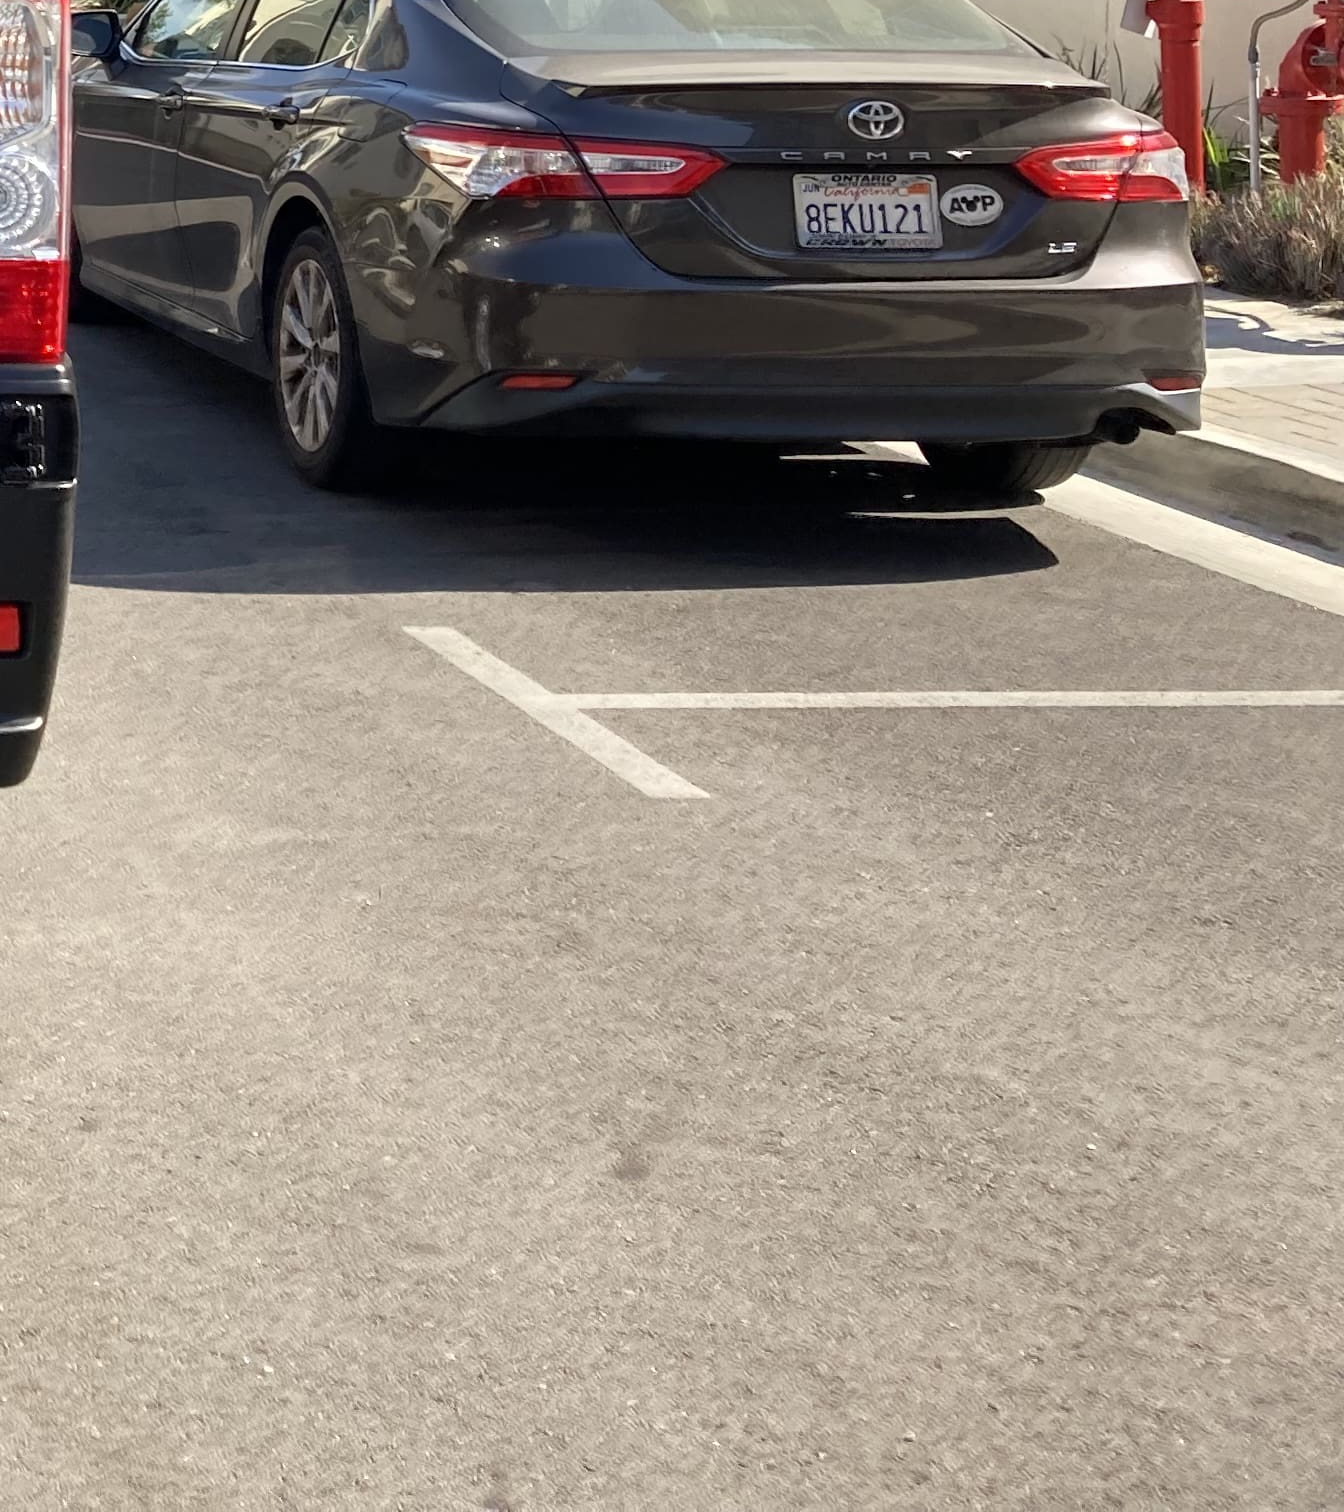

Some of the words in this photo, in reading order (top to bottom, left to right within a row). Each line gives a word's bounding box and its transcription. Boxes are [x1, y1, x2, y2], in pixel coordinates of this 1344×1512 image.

[780, 150, 972, 160] CAMRY
[832, 174, 897, 183] ONTARIO
[803, 184, 820, 193] JUN
[824, 185, 909, 201] California
[805, 203, 929, 234] 8EKU121
